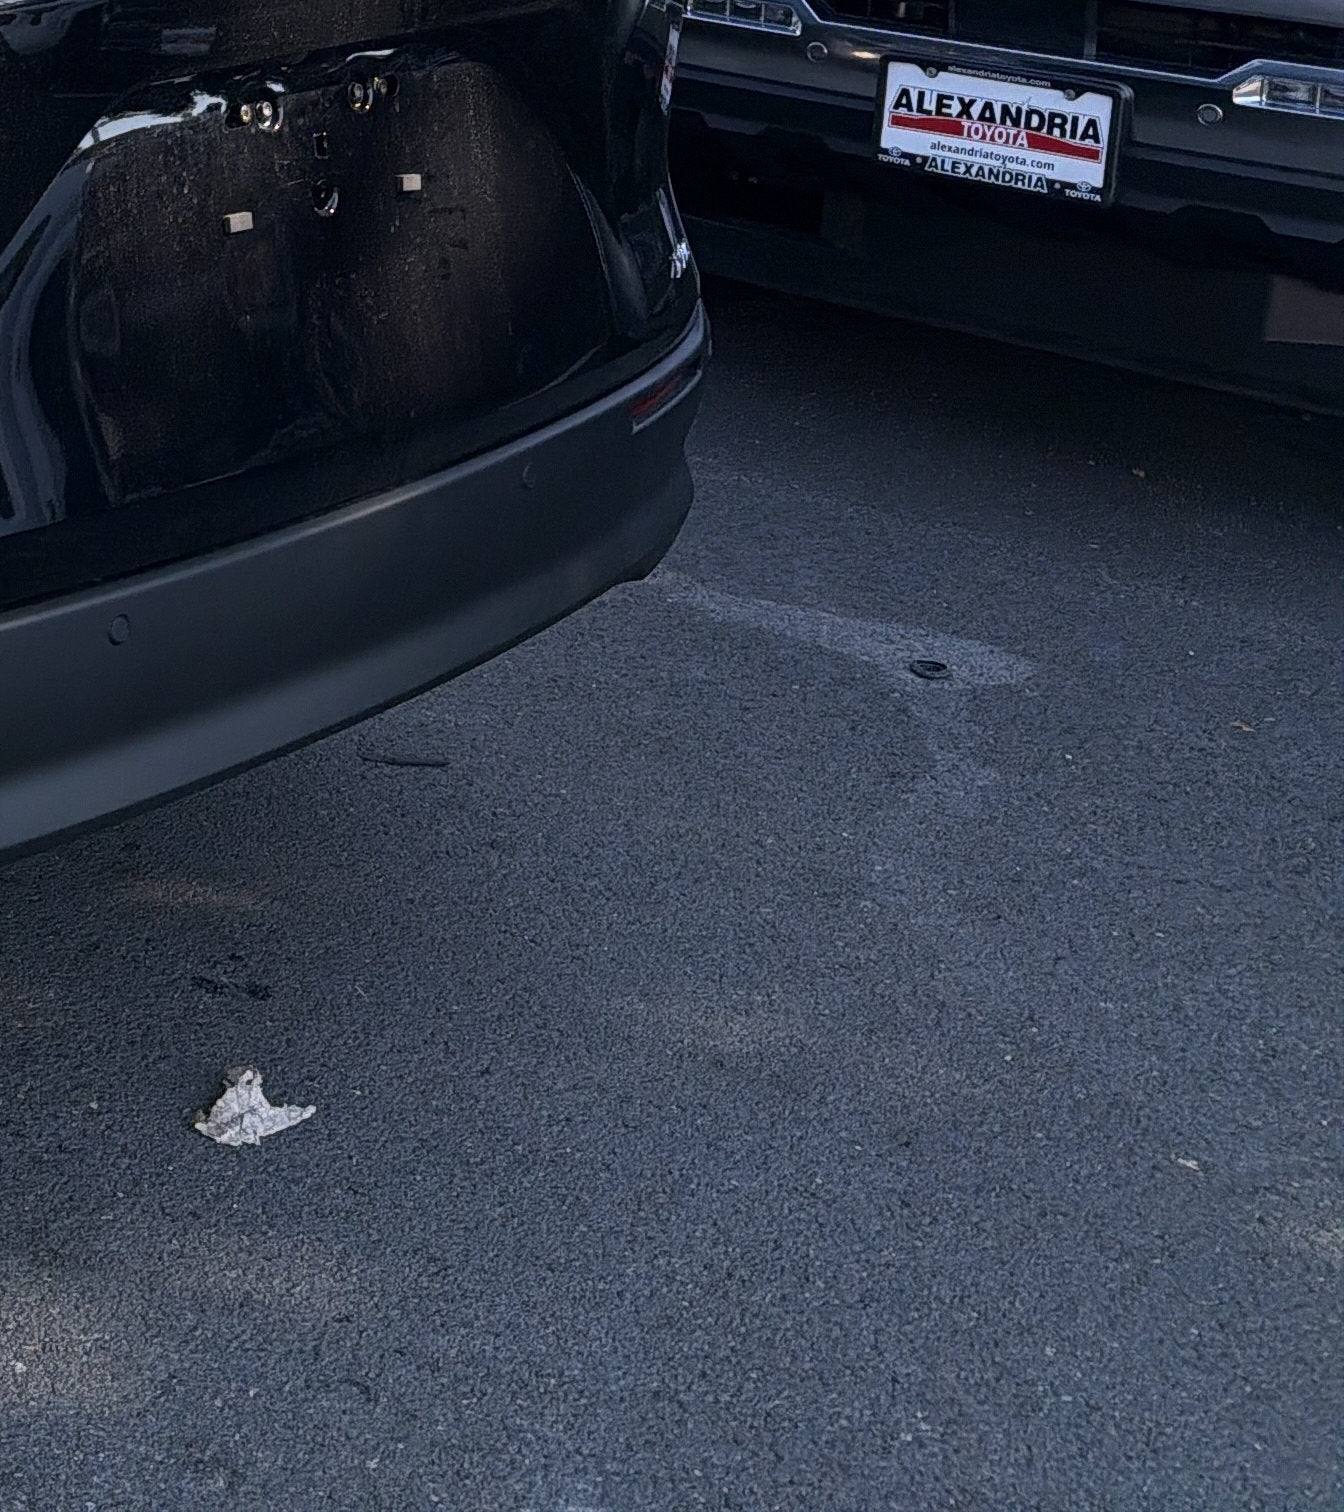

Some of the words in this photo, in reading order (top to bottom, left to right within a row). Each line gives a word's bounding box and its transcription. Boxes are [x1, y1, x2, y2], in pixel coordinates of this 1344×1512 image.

[947, 64, 1052, 88] alexandriatoyota.com
[892, 87, 1102, 145] ALEXANDRIA
[961, 120, 1029, 149] TOYOTA
[877, 153, 911, 167] TOYOTA
[929, 140, 1055, 172] alexandriatoyota.com
[924, 156, 1048, 194] ALEXANDRIA
[1064, 188, 1102, 203] TOYOTA
